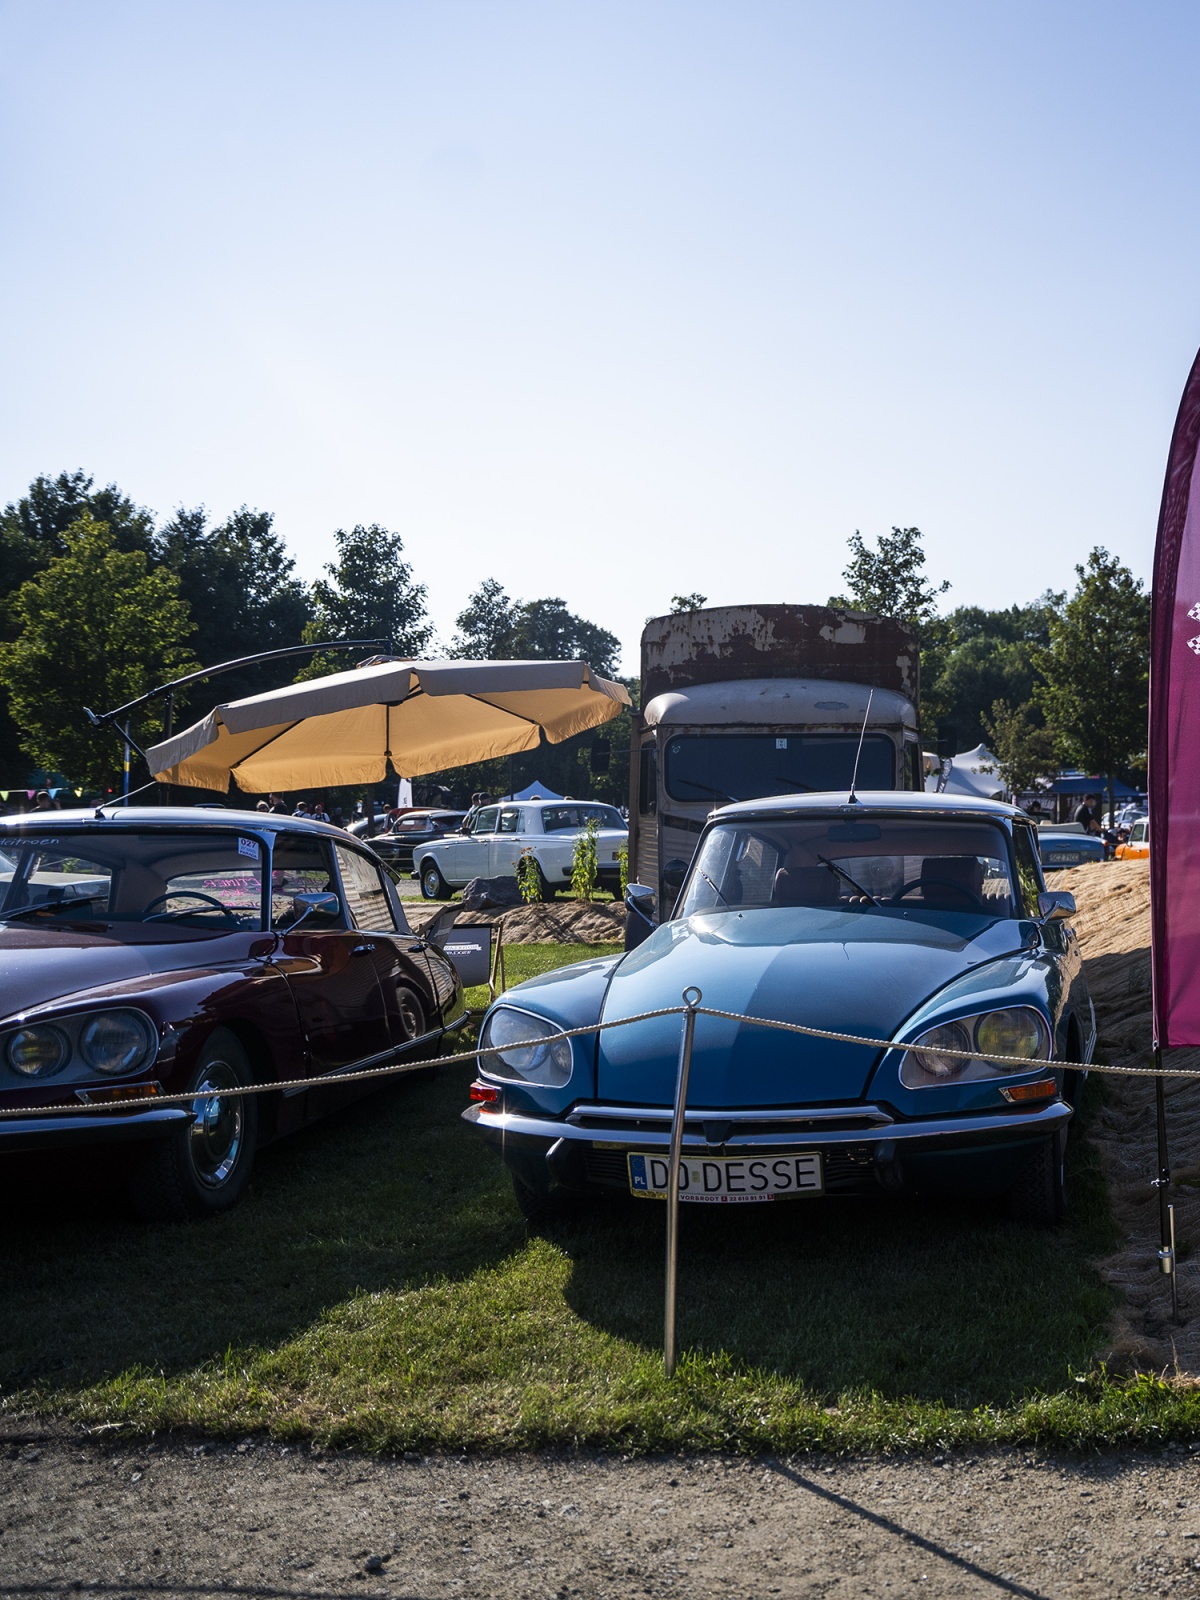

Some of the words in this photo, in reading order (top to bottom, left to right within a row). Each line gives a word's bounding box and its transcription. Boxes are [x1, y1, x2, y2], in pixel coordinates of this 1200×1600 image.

[240, 838, 257, 849] 027
[634, 1175, 646, 1185] PL
[702, 1158, 817, 1193] DESSE
